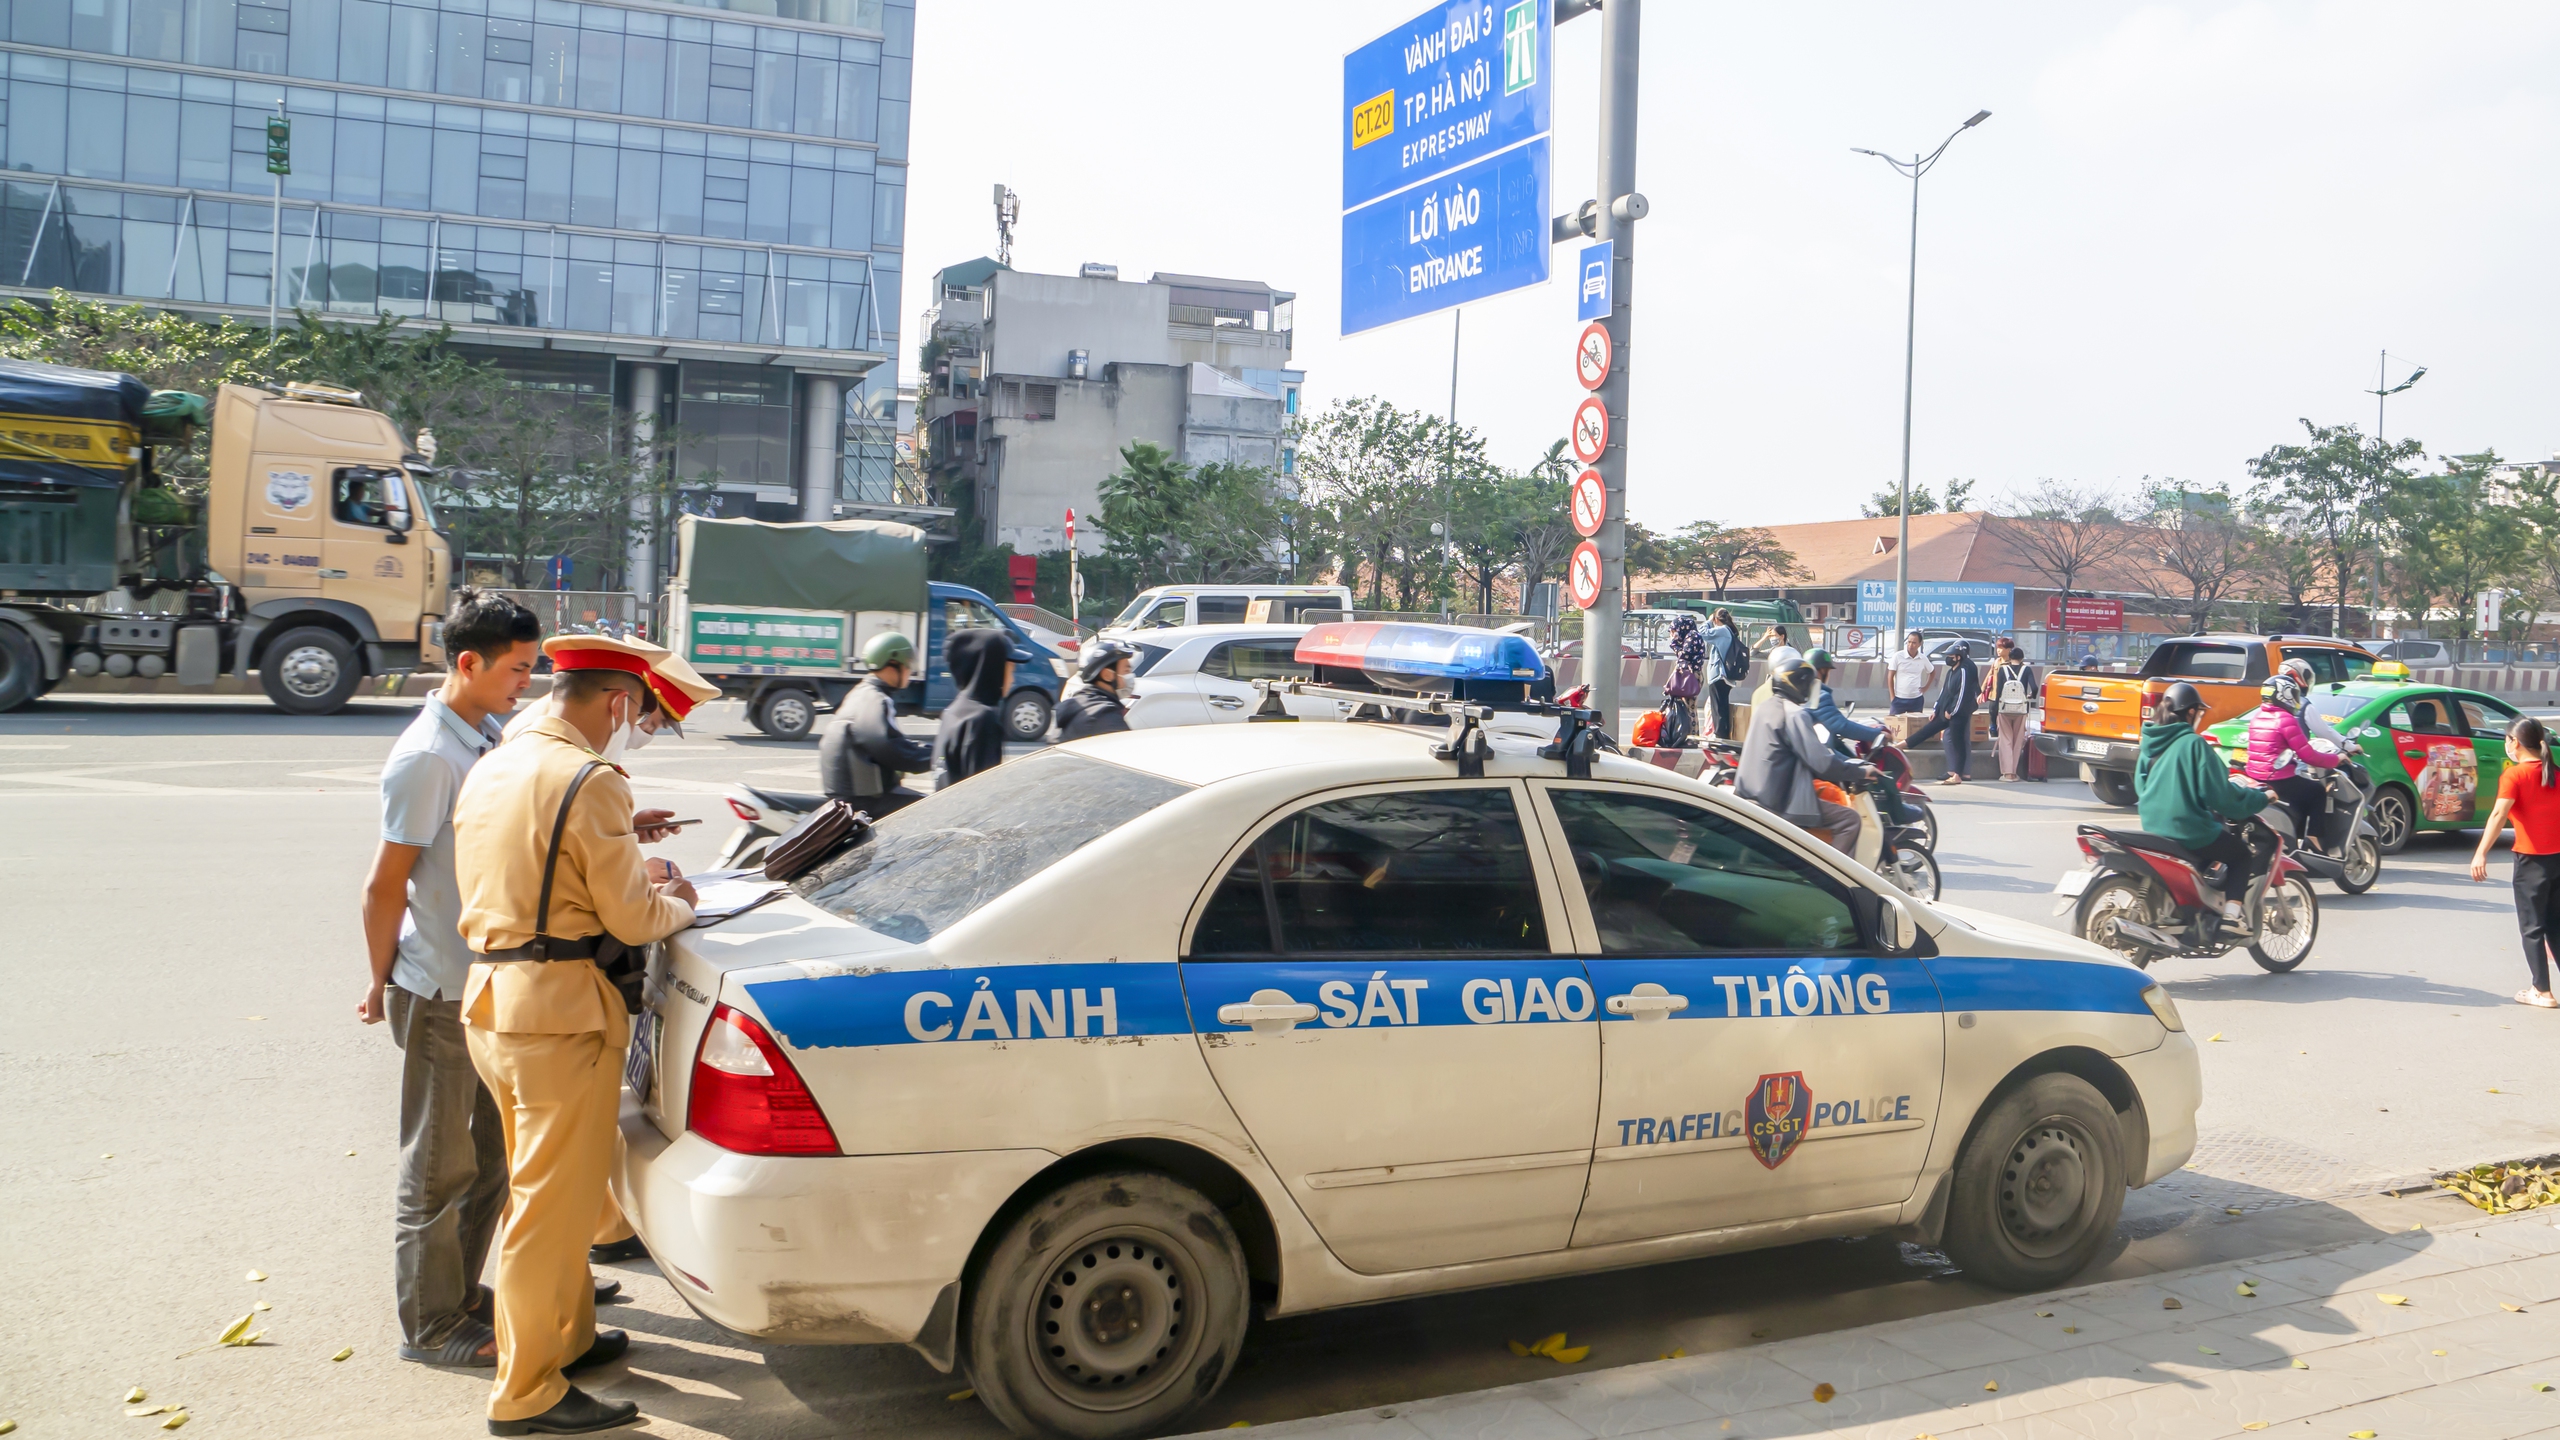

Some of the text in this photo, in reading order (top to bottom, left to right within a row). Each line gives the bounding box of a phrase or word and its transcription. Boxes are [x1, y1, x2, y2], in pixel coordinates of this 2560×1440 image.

[1404, 4, 1493, 75] VÀNH ĐAI 3
[1460, 58, 1490, 103] NỘI
[1355, 99, 1391, 139] CT.20
[1403, 110, 1491, 168] EXPRESSWAY
[1410, 191, 1438, 244] LỐI
[1444, 183, 1480, 232] VÀO
[1411, 246, 1482, 293] ENTRANCE
[1924, 602, 1942, 615] HỌC
[1952, 602, 1975, 613] THCS
[1985, 603, 2008, 614] THPT
[1974, 587, 2007, 595] GMEINER
[1918, 615, 1967, 624] GMEINER
[1970, 614, 1984, 625] HÀ
[1988, 615, 2007, 627] NỘI
[2049, 716, 2136, 731] RANGER
[903, 966, 1890, 1042] CẢNH SÁT GIAO THÔNG
[1617, 1095, 1911, 1146] TRAFFIC POLICE
